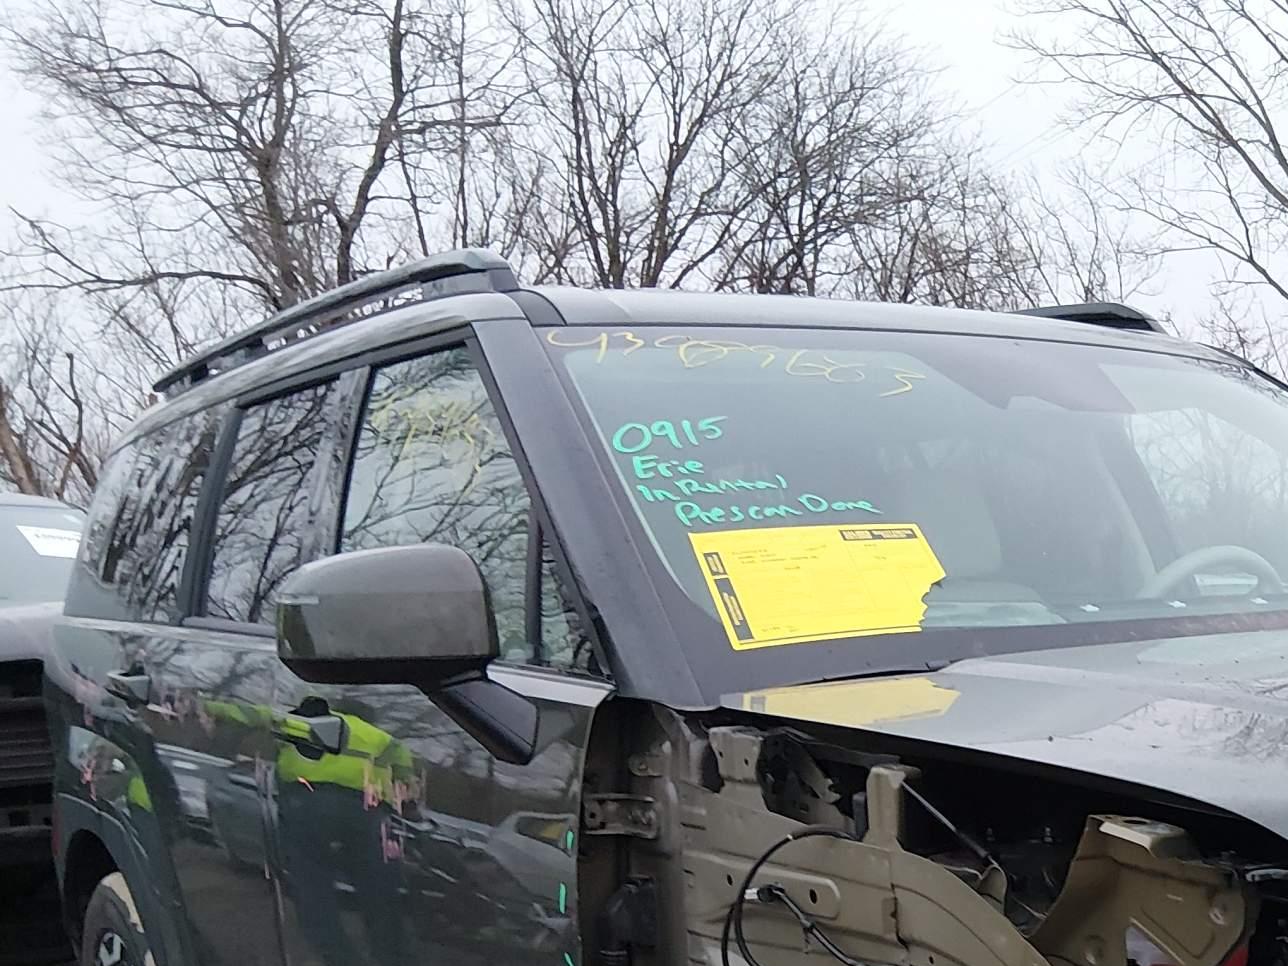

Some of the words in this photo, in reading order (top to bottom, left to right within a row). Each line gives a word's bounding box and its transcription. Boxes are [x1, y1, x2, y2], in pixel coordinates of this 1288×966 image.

[612, 415, 729, 453] 0915
[632, 454, 705, 479] Erie
[673, 473, 788, 496] Rental
[797, 493, 884, 515] Done
